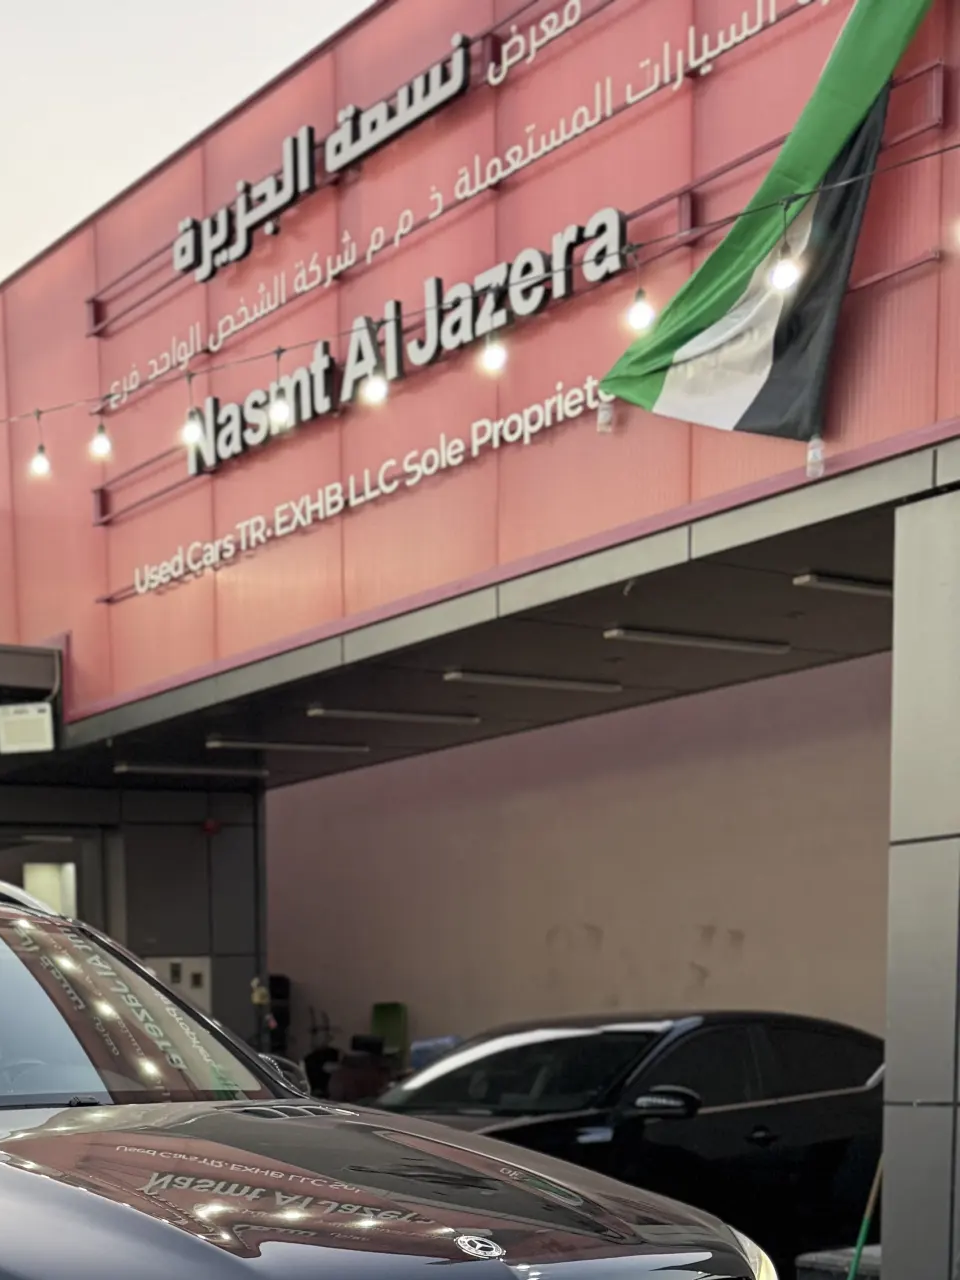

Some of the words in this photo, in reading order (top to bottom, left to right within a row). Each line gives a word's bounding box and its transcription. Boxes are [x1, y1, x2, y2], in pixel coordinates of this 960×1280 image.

[324, 32, 471, 174] نسمة
[487, 0, 581, 86] معرض
[454, 76, 613, 201] المستعملة
[173, 124, 315, 282] الجزيرة
[293, 229, 358, 295] شركة
[147, 321, 203, 380] الواحد
[184, 341, 336, 476] Nasmt
[340, 299, 404, 403] Al
[406, 206, 627, 366] Jazera
[208, 271, 287, 353] الشخص
[134, 546, 185, 594] Used
[186, 533, 236, 573] Cars
[274, 482, 345, 537] EXHB
[348, 459, 400, 507] LLC
[403, 437, 465, 486] Sole
